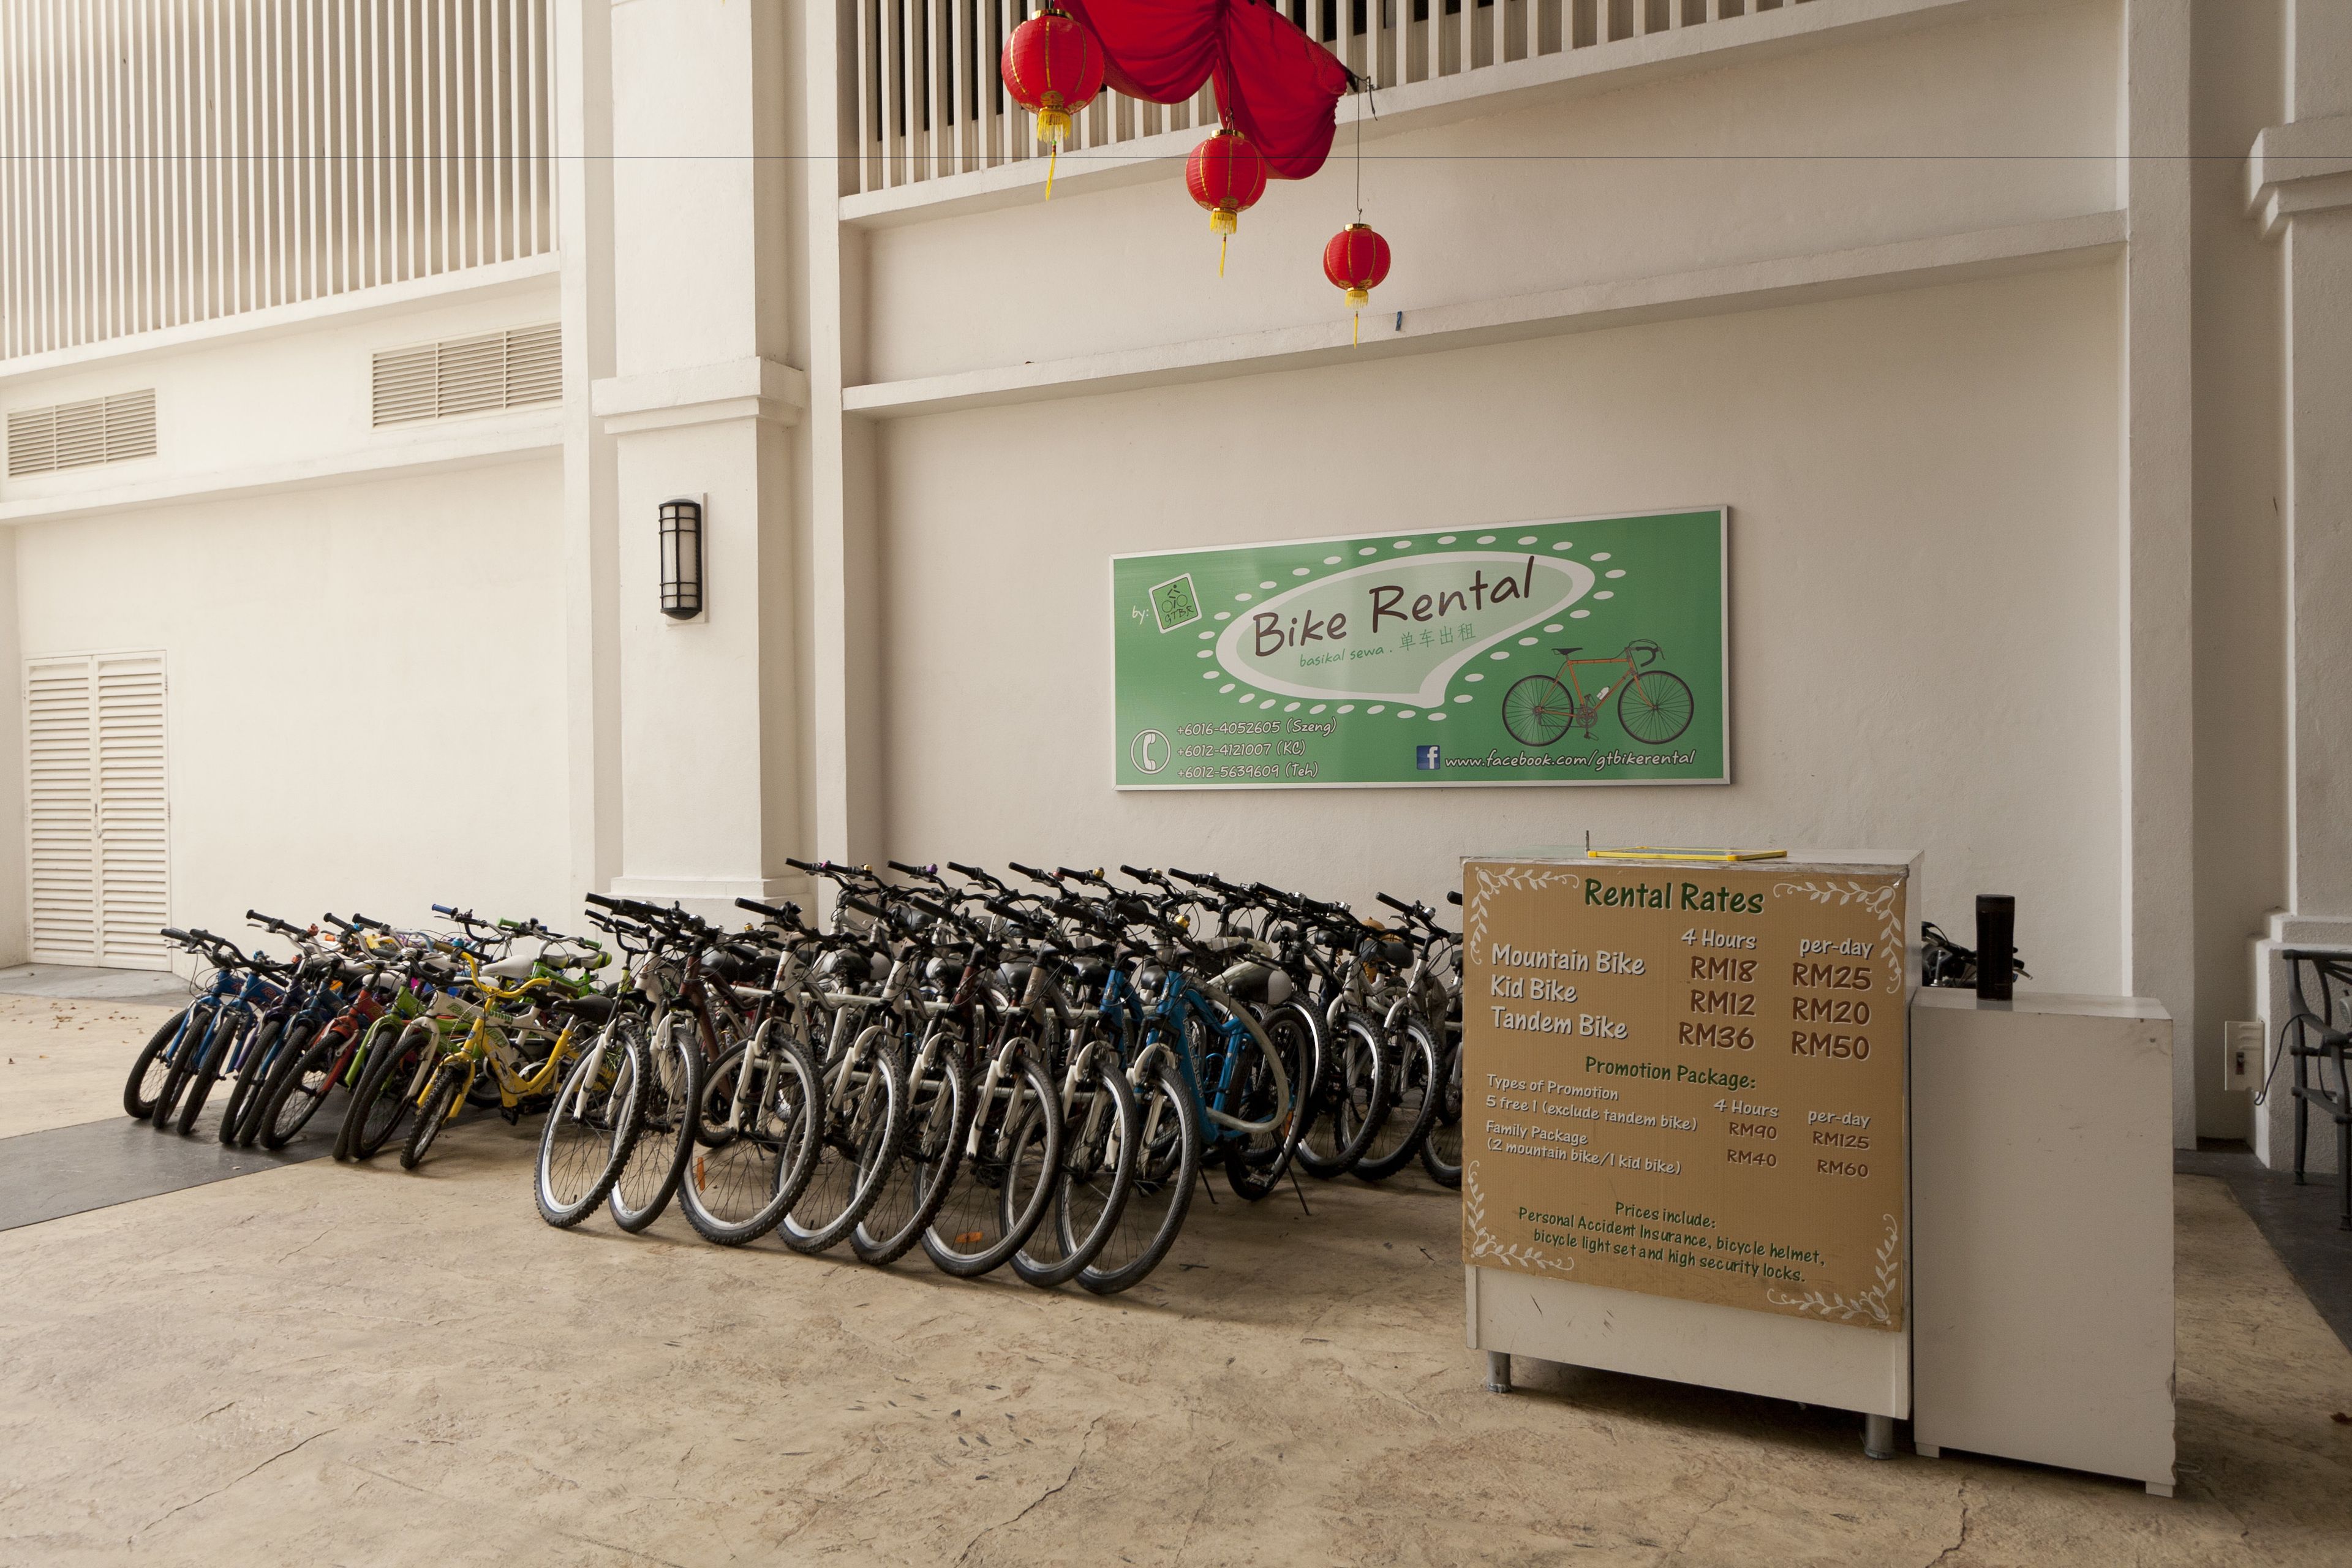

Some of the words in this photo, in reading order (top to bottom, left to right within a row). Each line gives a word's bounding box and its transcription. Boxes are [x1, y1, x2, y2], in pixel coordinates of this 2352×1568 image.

[1132, 606, 1148, 625] by:
[1164, 606, 1194, 627] GTBR
[1253, 609, 1347, 657] Bike
[1369, 556, 1534, 633] Rental
[1399, 622, 1476, 650] 单车出租
[1300, 649, 1346, 667] basikal
[1177, 720, 1280, 736] +6016-4052605
[1286, 717, 1337, 737] (Szeng)
[1177, 743, 1272, 758] +6012-4121007
[1276, 740, 1306, 756] (KC)
[1444, 749, 1696, 772] www.facebook.com/gtbikerental
[1177, 765, 1280, 779] +6012-5639609
[1286, 761, 1318, 778] (Teh)
[1585, 878, 1673, 910] Rental
[1681, 882, 1764, 914] Rates
[1681, 928, 1697, 946] 4
[1702, 929, 1757, 950] Hours
[1800, 938, 1873, 959] per-day
[1491, 943, 1589, 972] Mountain
[1596, 950, 1646, 976] Bike
[1691, 956, 1758, 983] RM18
[1793, 962, 1872, 990] RM25
[1491, 974, 1524, 998] Kid
[1530, 978, 1577, 1003] Bike
[1691, 989, 1756, 1016] RM12
[1792, 997, 1871, 1025] RM20
[1491, 1006, 1572, 1035] Tandem
[1579, 1014, 1628, 1040] Bike
[1679, 1022, 1755, 1050] RM36
[1792, 1031, 1871, 1061] RM50
[1487, 1074, 1526, 1091] Types
[1530, 1080, 1544, 1092] of
[1548, 1080, 1619, 1101] Promotion
[1585, 1056, 1672, 1081] Promotion
[1677, 1065, 1756, 1091] Package:
[1486, 1095, 1496, 1108] 5
[1500, 1097, 1529, 1112] free
[1543, 1101, 1600, 1120] (exclude
[1604, 1109, 1656, 1127] tandem
[1661, 1115, 1698, 1132] bike)
[1714, 1098, 1727, 1112] 4
[1732, 1099, 1779, 1117] Hours
[1808, 1110, 1871, 1128] per-day
[1486, 1120, 1528, 1138] Family
[1531, 1125, 1588, 1145] Package
[1729, 1121, 1777, 1140] RM90
[1813, 1131, 1870, 1150] RM125
[1487, 1137, 1502, 1152] (2
[1506, 1142, 1567, 1161] mountain
[1619, 1155, 1640, 1170] kid
[1645, 1159, 1681, 1175] bike)
[1727, 1149, 1777, 1167] RM40
[1817, 1159, 1868, 1178] RM60
[1615, 1201, 1659, 1221] Prices
[1663, 1208, 1716, 1229] include:
[1518, 1207, 1574, 1227] Personal
[1578, 1216, 1636, 1237] Accident
[1640, 1225, 1712, 1250] Insurance,
[1717, 1236, 1765, 1256] bicycle
[1770, 1243, 1825, 1266] helmet,
[1534, 1229, 1577, 1248] bicycle
[1583, 1236, 1611, 1254] light
[1613, 1243, 1637, 1256] set
[1639, 1248, 1663, 1261] and
[1668, 1248, 1695, 1267] high
[1700, 1256, 1759, 1277] security
[1763, 1263, 1806, 1282] locks.
